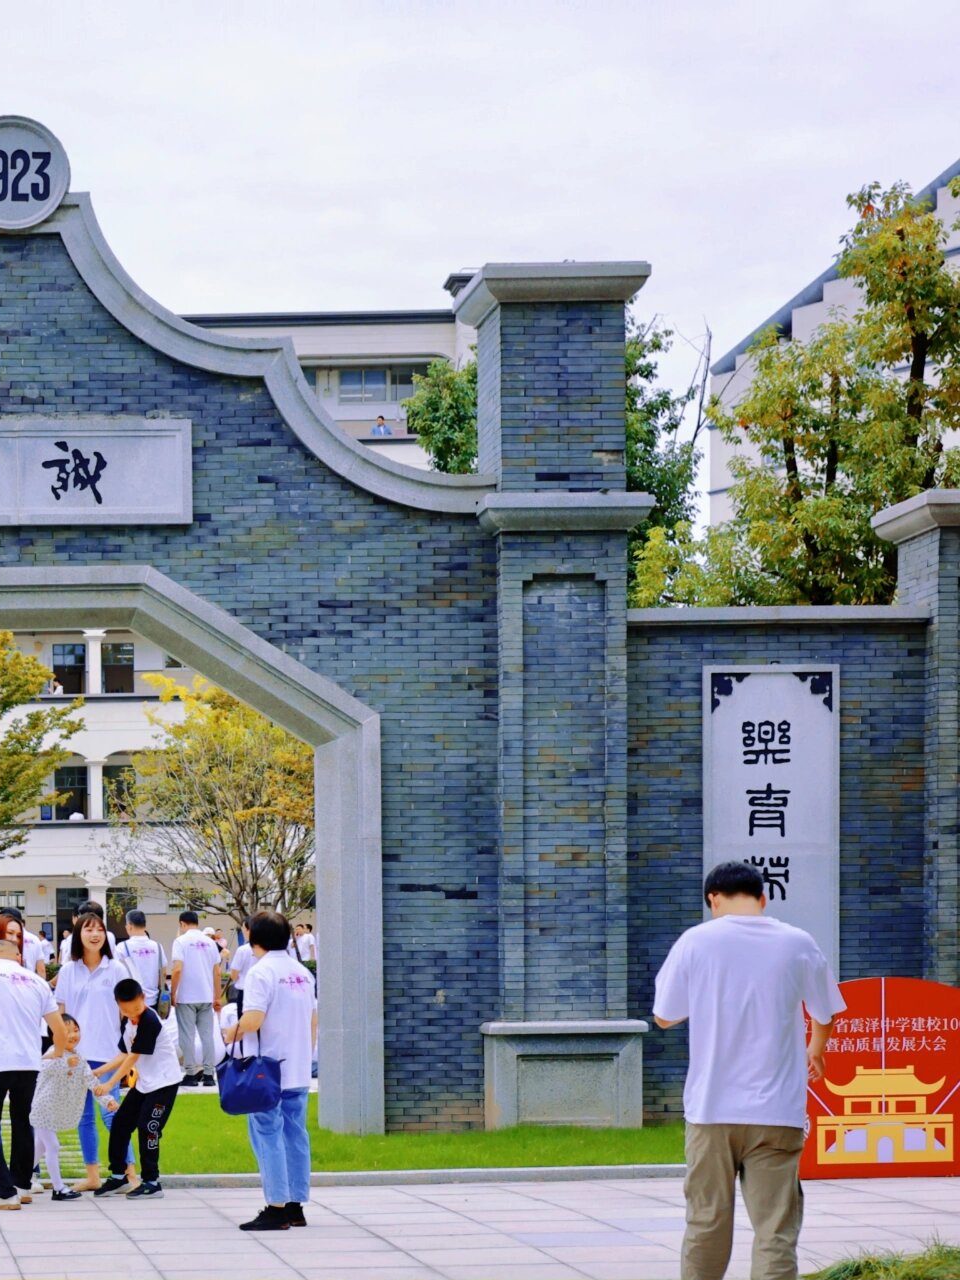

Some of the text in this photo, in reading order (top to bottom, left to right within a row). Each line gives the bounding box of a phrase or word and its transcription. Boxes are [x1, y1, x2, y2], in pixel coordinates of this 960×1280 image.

[825, 1035, 947, 1053] 暨高质量发展大会
